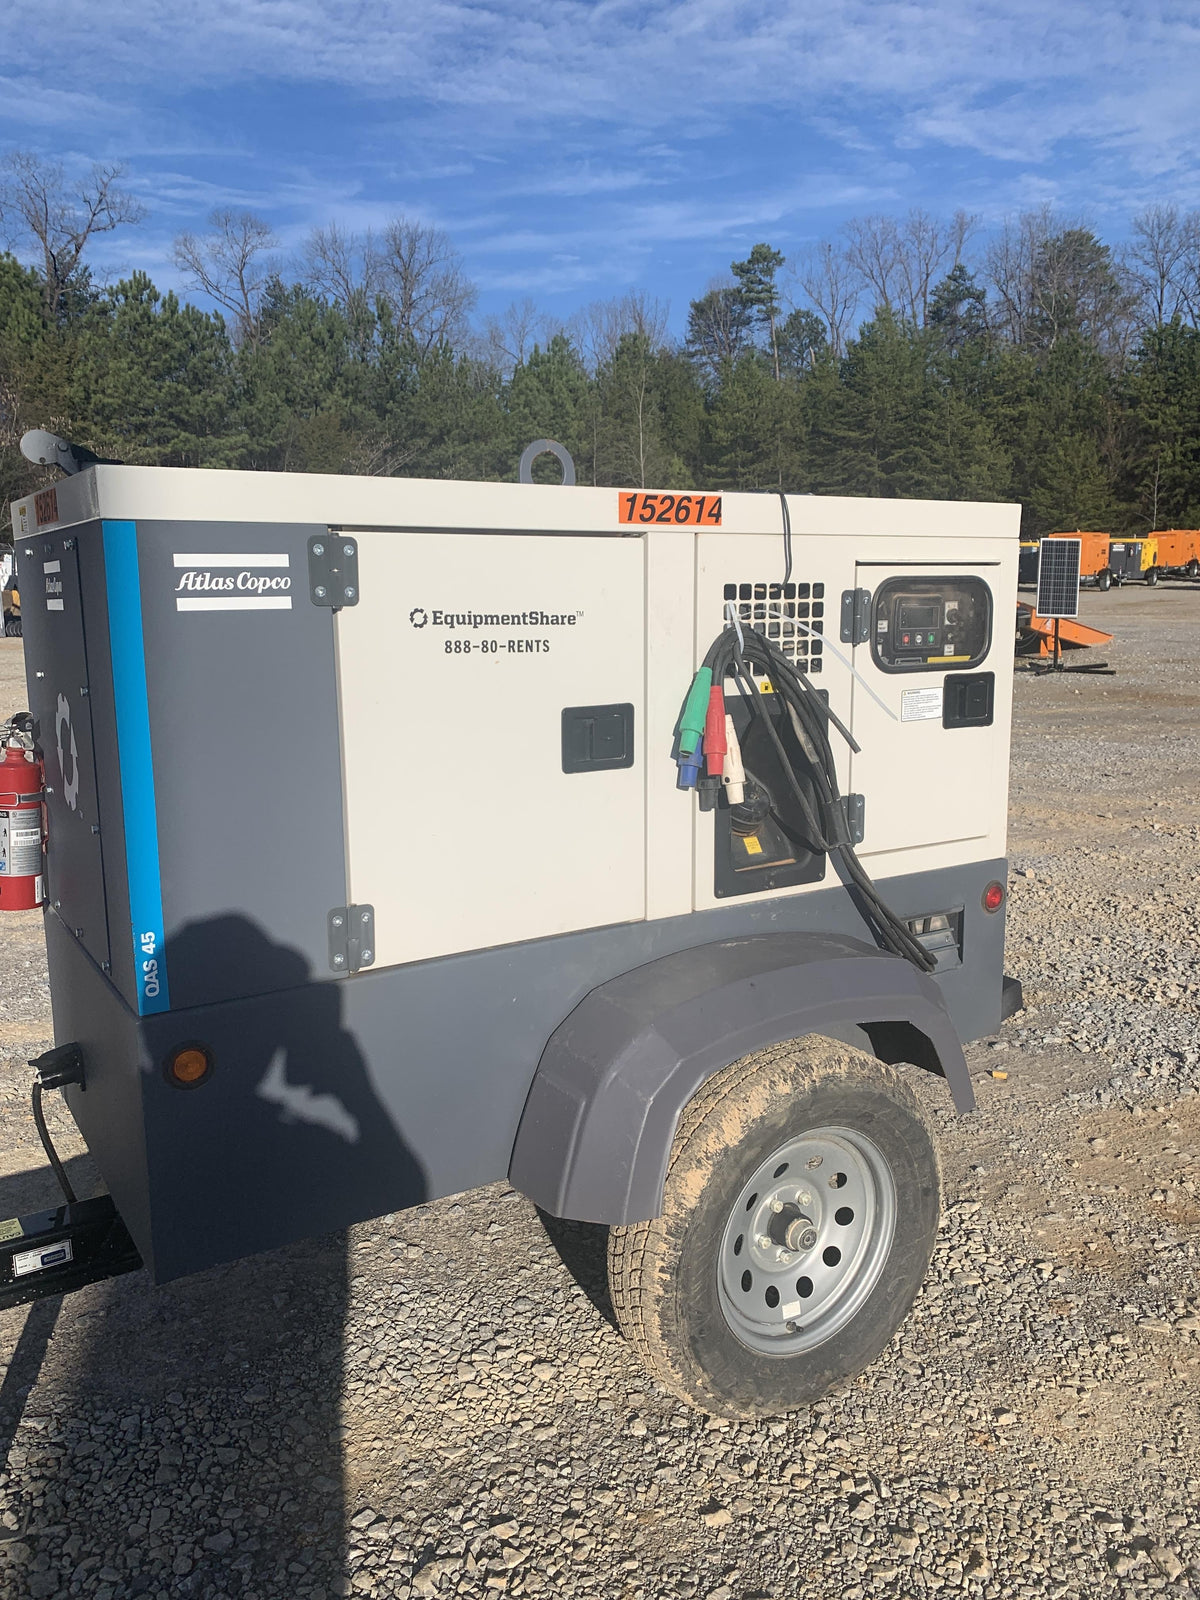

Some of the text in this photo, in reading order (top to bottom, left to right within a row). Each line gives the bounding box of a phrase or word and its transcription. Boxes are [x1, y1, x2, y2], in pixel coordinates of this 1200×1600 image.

[626, 493, 722, 523] 152614
[175, 571, 292, 594] Atlas Copco
[432, 610, 577, 629] EquipmentShare
[444, 640, 550, 654] 888-80-RENTS
[141, 931, 160, 997] QAS 45
